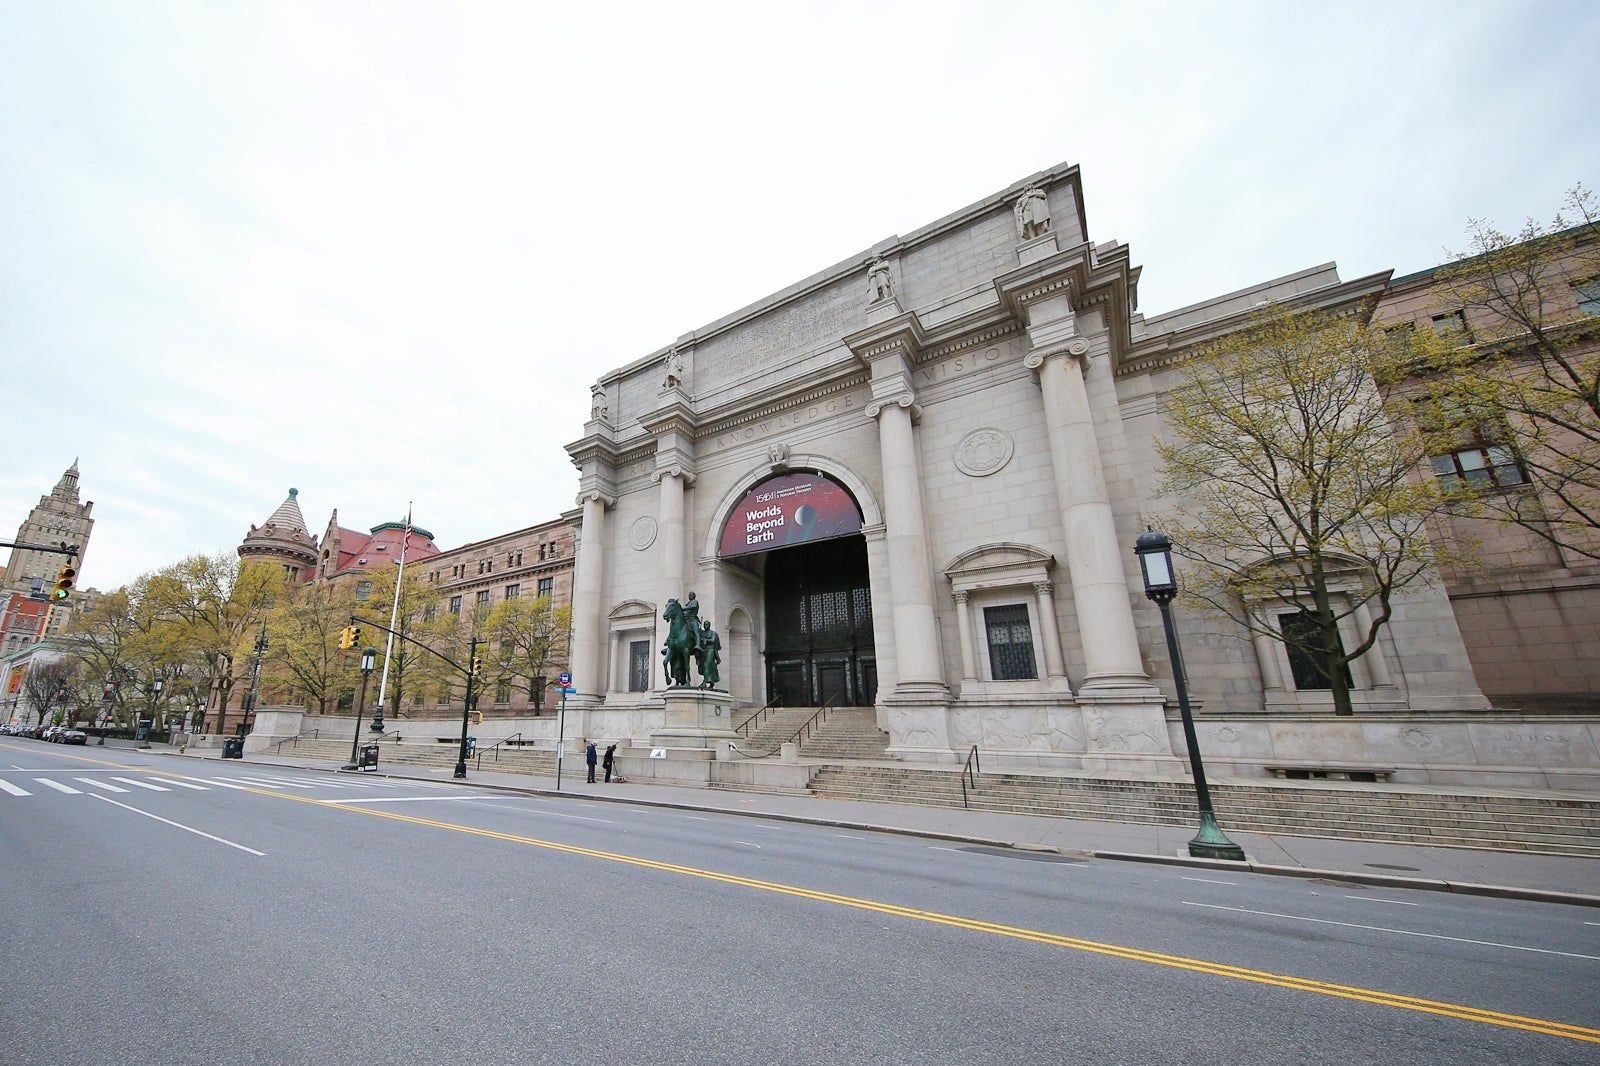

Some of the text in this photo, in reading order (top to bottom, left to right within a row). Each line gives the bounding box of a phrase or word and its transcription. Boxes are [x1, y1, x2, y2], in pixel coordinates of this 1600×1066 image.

[922, 339, 1025, 380] VISION
[716, 395, 854, 448] KNOWLEDGE
[746, 505, 782, 521] Worlds
[746, 515, 784, 533] Beyond
[746, 530, 774, 545] Earth
[1490, 732, 1569, 743] AUTHOR
